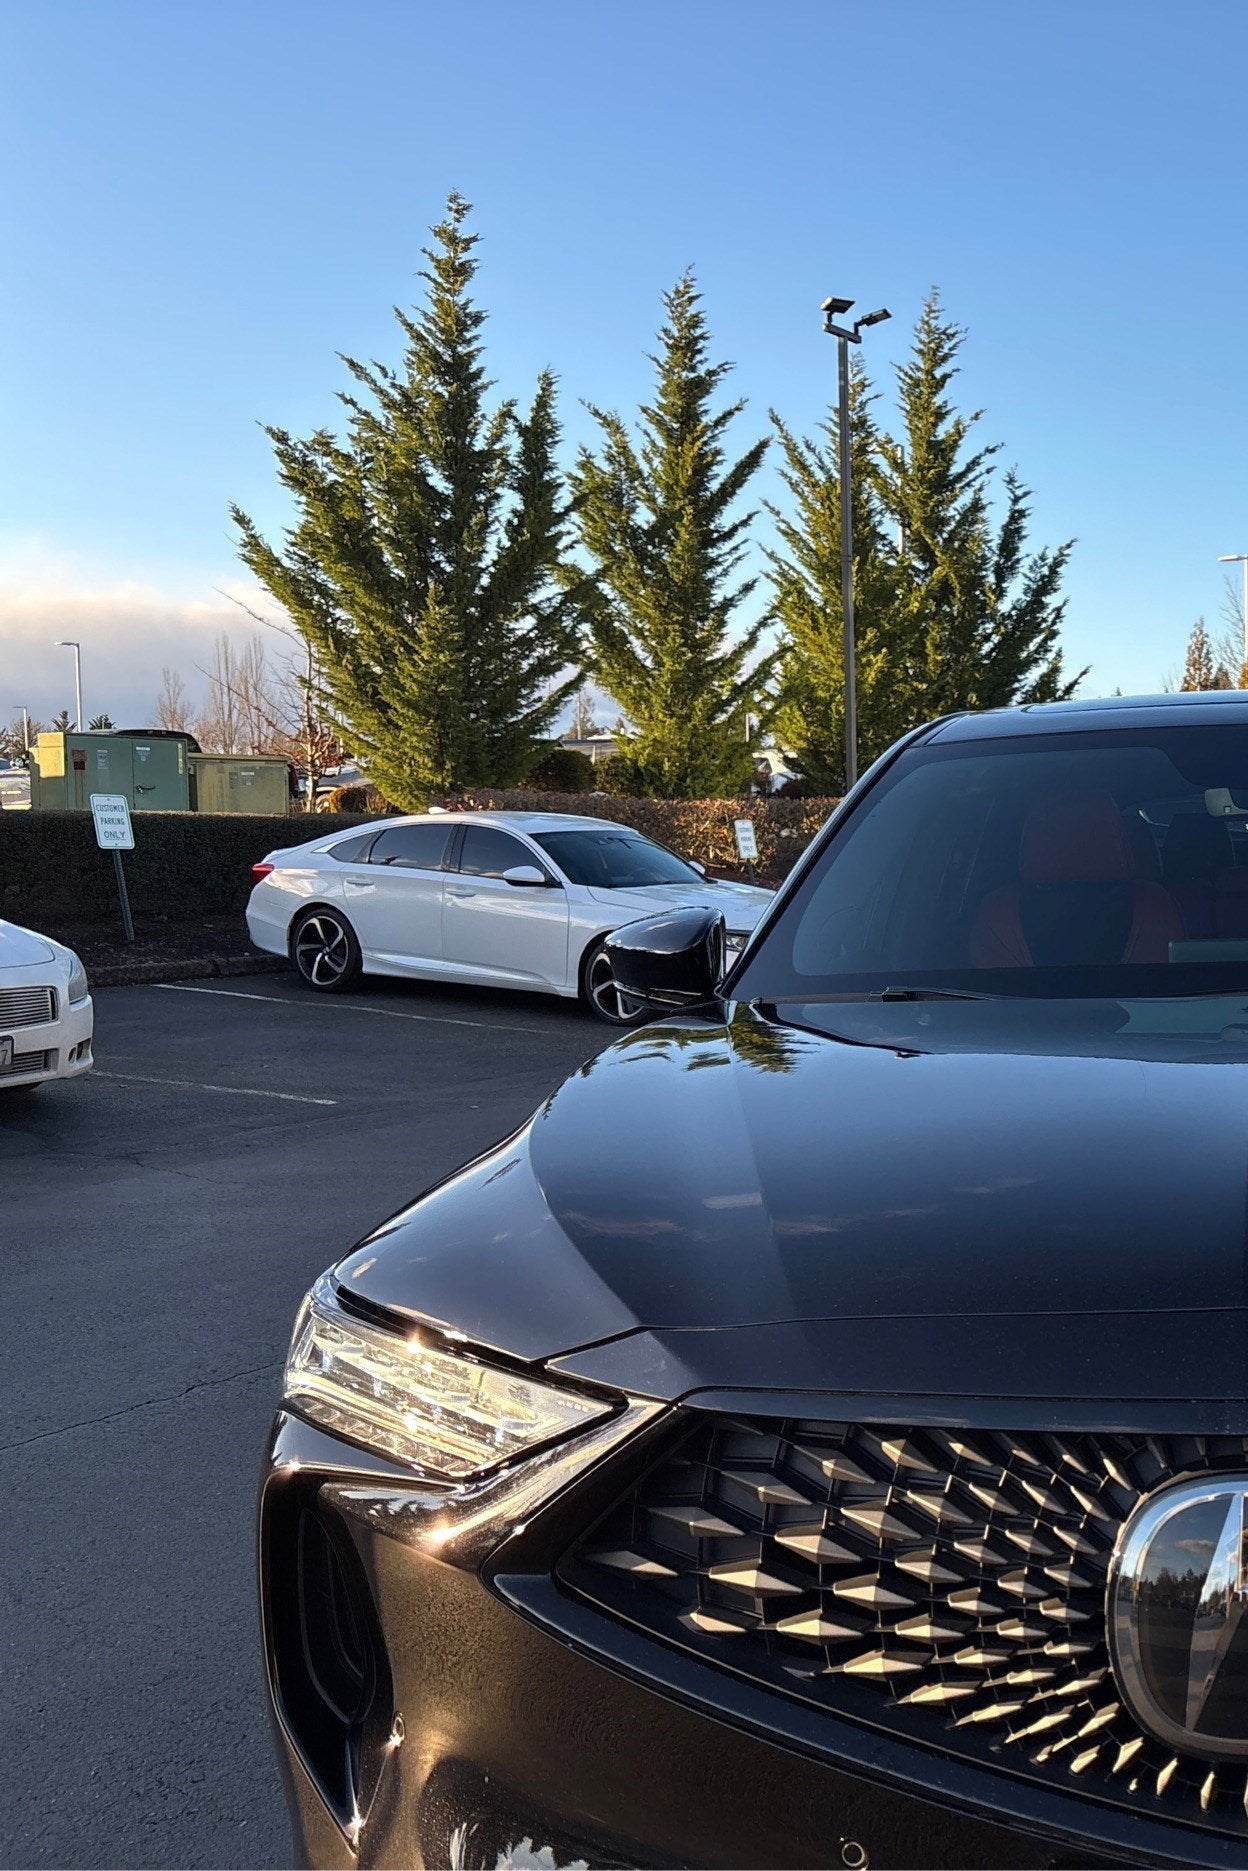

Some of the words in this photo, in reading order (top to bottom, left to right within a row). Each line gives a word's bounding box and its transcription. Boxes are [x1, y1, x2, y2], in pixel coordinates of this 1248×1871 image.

[95, 804, 125, 813] CUSTOMER
[100, 817, 125, 826] PARKING
[103, 831, 126, 839] ONLY
